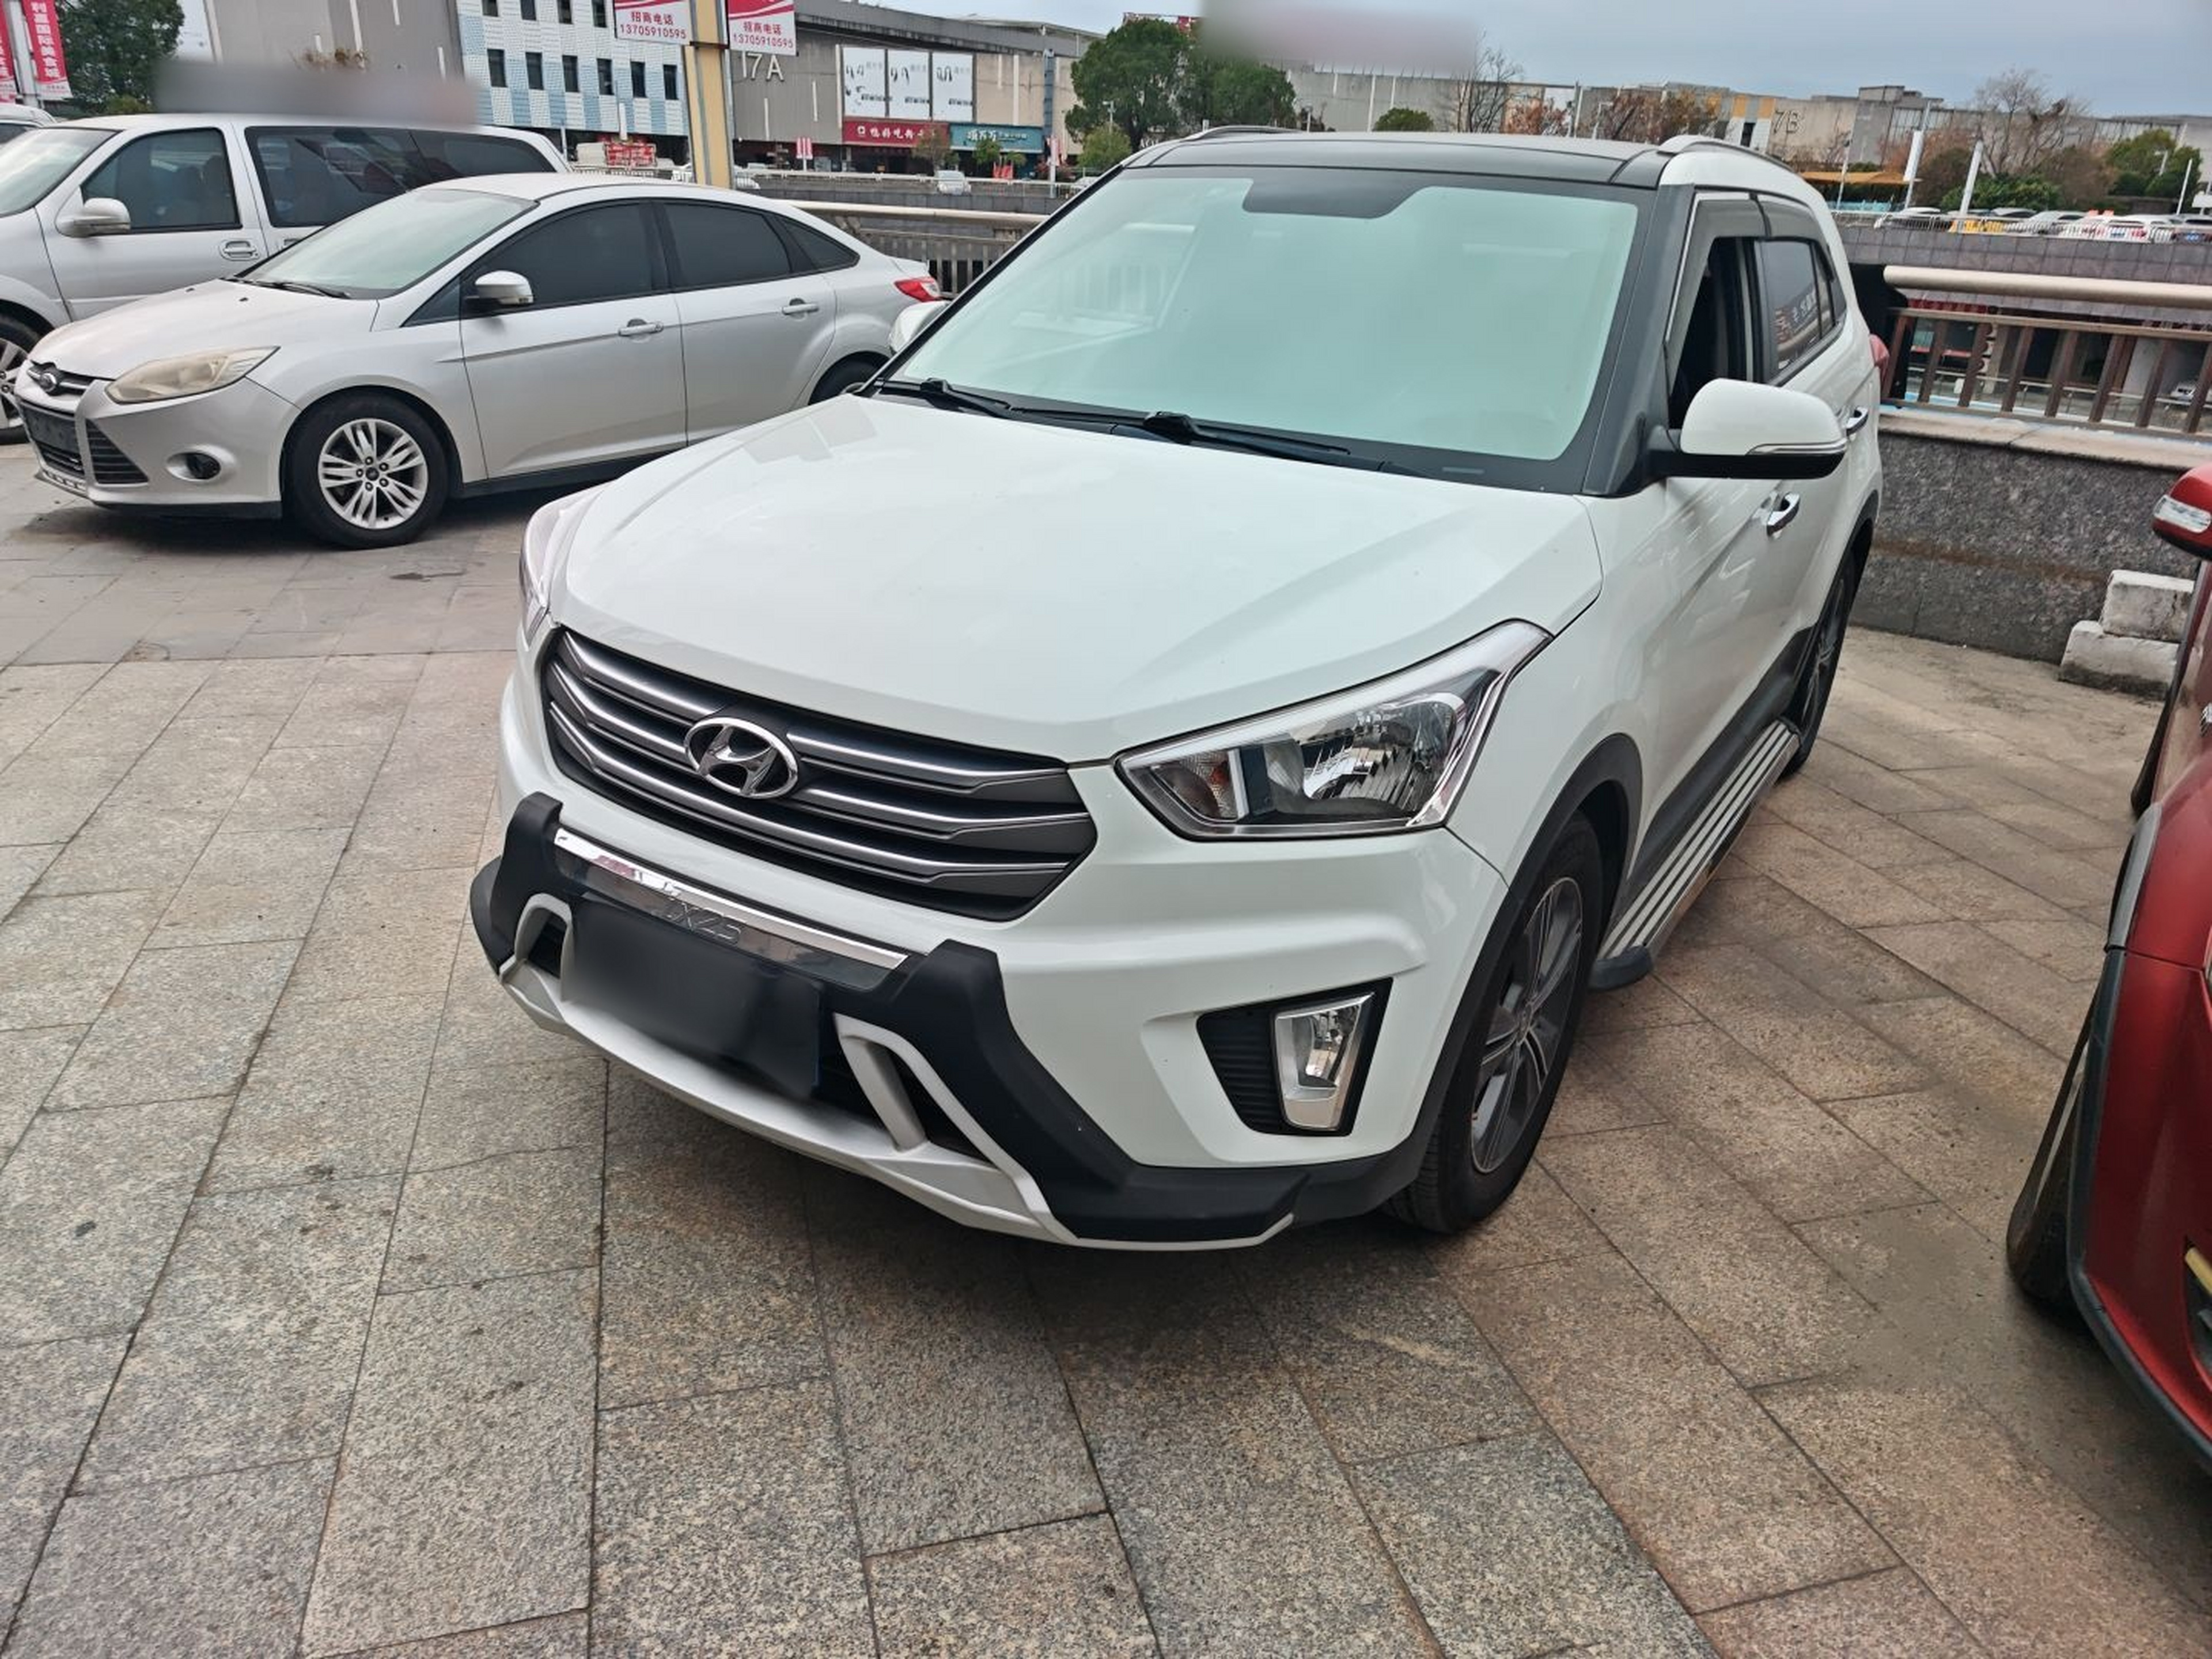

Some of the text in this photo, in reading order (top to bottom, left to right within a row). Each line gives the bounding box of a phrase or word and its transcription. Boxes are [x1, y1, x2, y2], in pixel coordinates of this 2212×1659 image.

[631, 12, 673, 25] 招商电话
[620, 24, 687, 39] 13705910595
[743, 21, 782, 35] 招商电话
[733, 33, 793, 48] 13705910595
[742, 51, 784, 81] 17A
